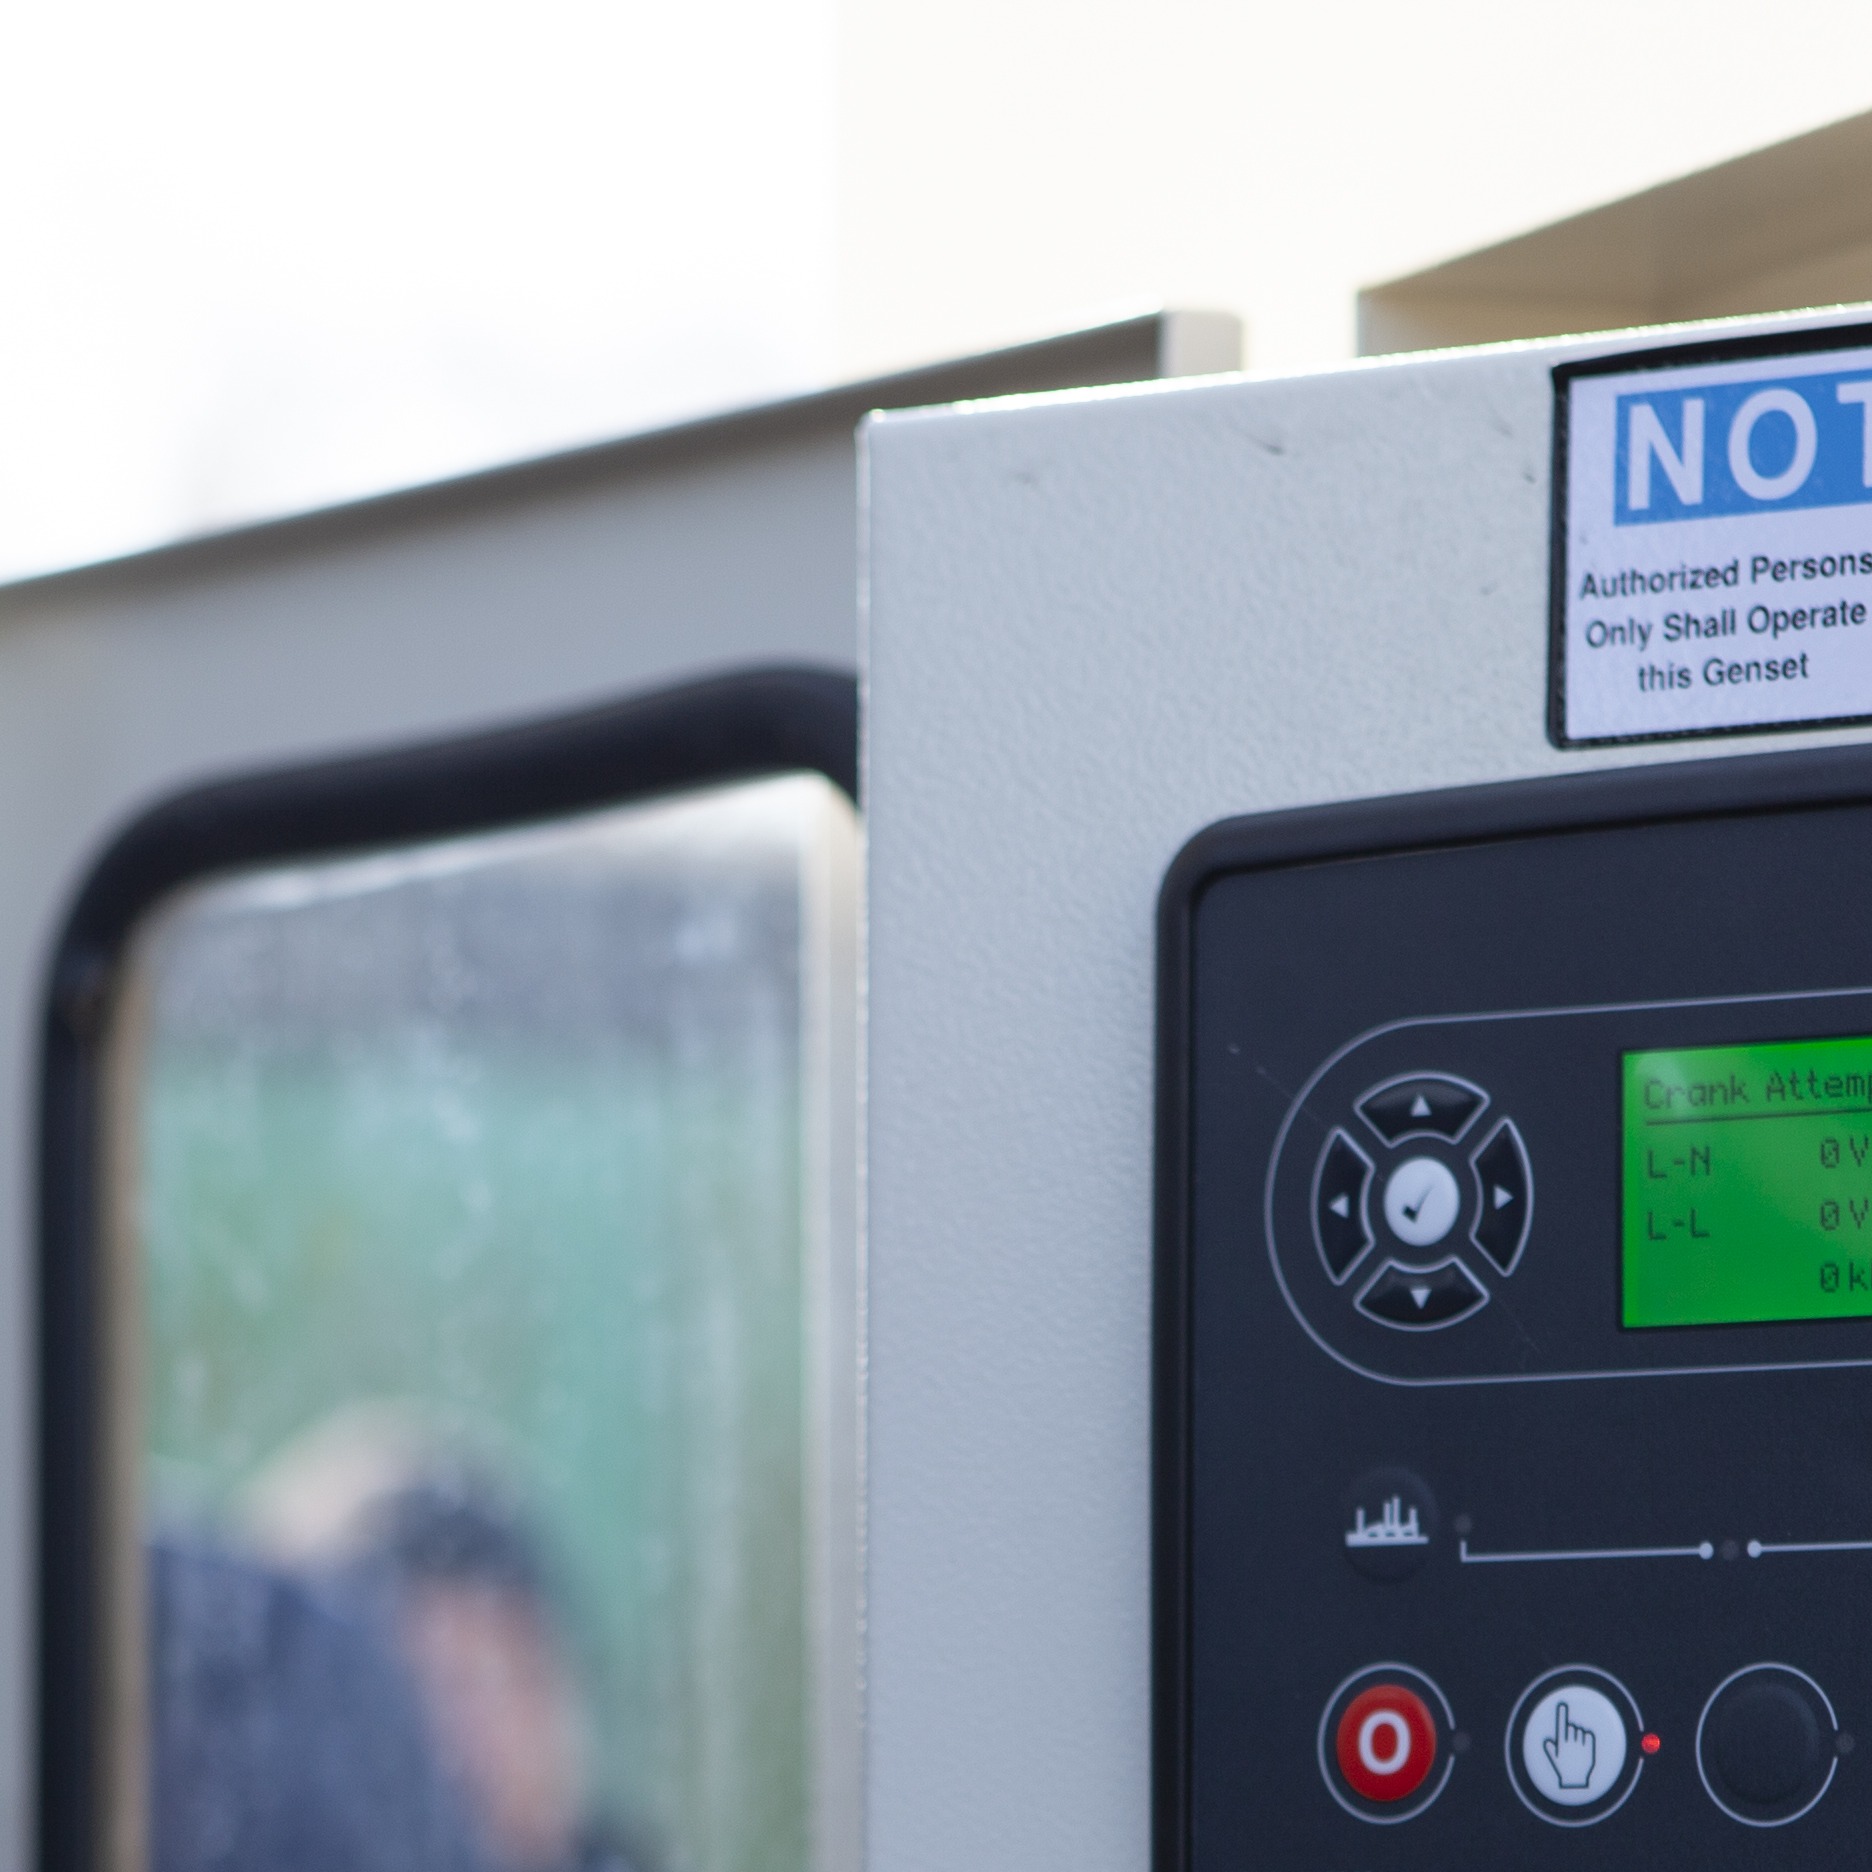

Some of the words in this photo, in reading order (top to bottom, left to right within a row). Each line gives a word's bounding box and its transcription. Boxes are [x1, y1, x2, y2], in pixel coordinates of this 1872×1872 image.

[1580, 559, 1740, 601] Authorized
[1585, 616, 1653, 653] Only
[1663, 609, 1737, 642] Shall
[1747, 600, 1868, 639] Operate
[1638, 661, 1692, 691] this
[1702, 653, 1810, 686] Genset
[1644, 1075, 1748, 1110] Crank
[1646, 1145, 1712, 1180] L-N
[1646, 1208, 1710, 1241] L-L
